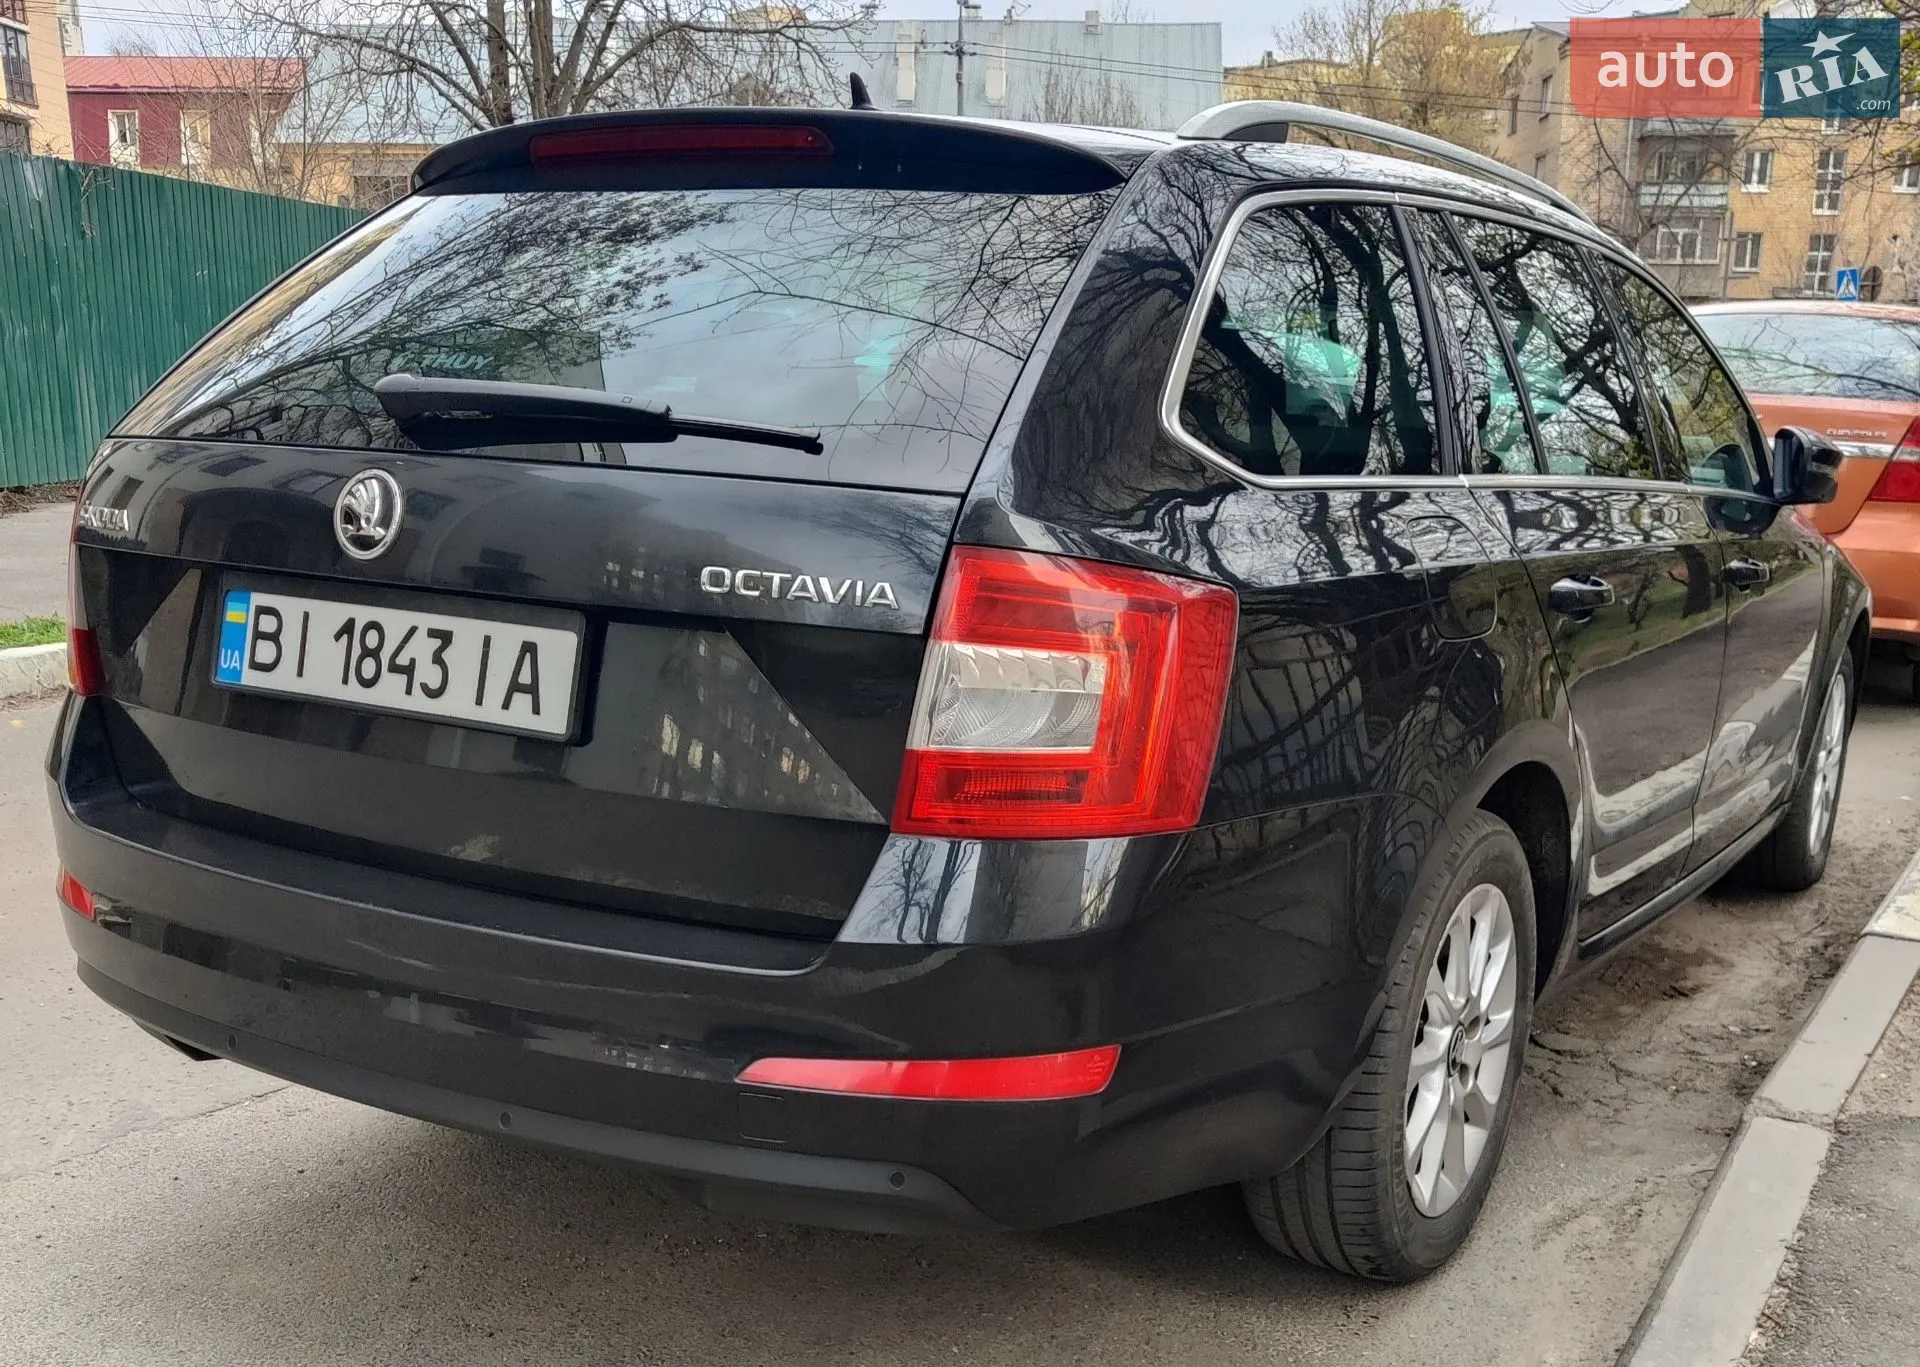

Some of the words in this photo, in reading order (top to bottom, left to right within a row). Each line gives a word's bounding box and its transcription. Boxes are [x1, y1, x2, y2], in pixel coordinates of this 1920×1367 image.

[701, 566, 899, 610] OCTAVIA
[220, 647, 241, 671] UA
[333, 616, 454, 700] 1843
